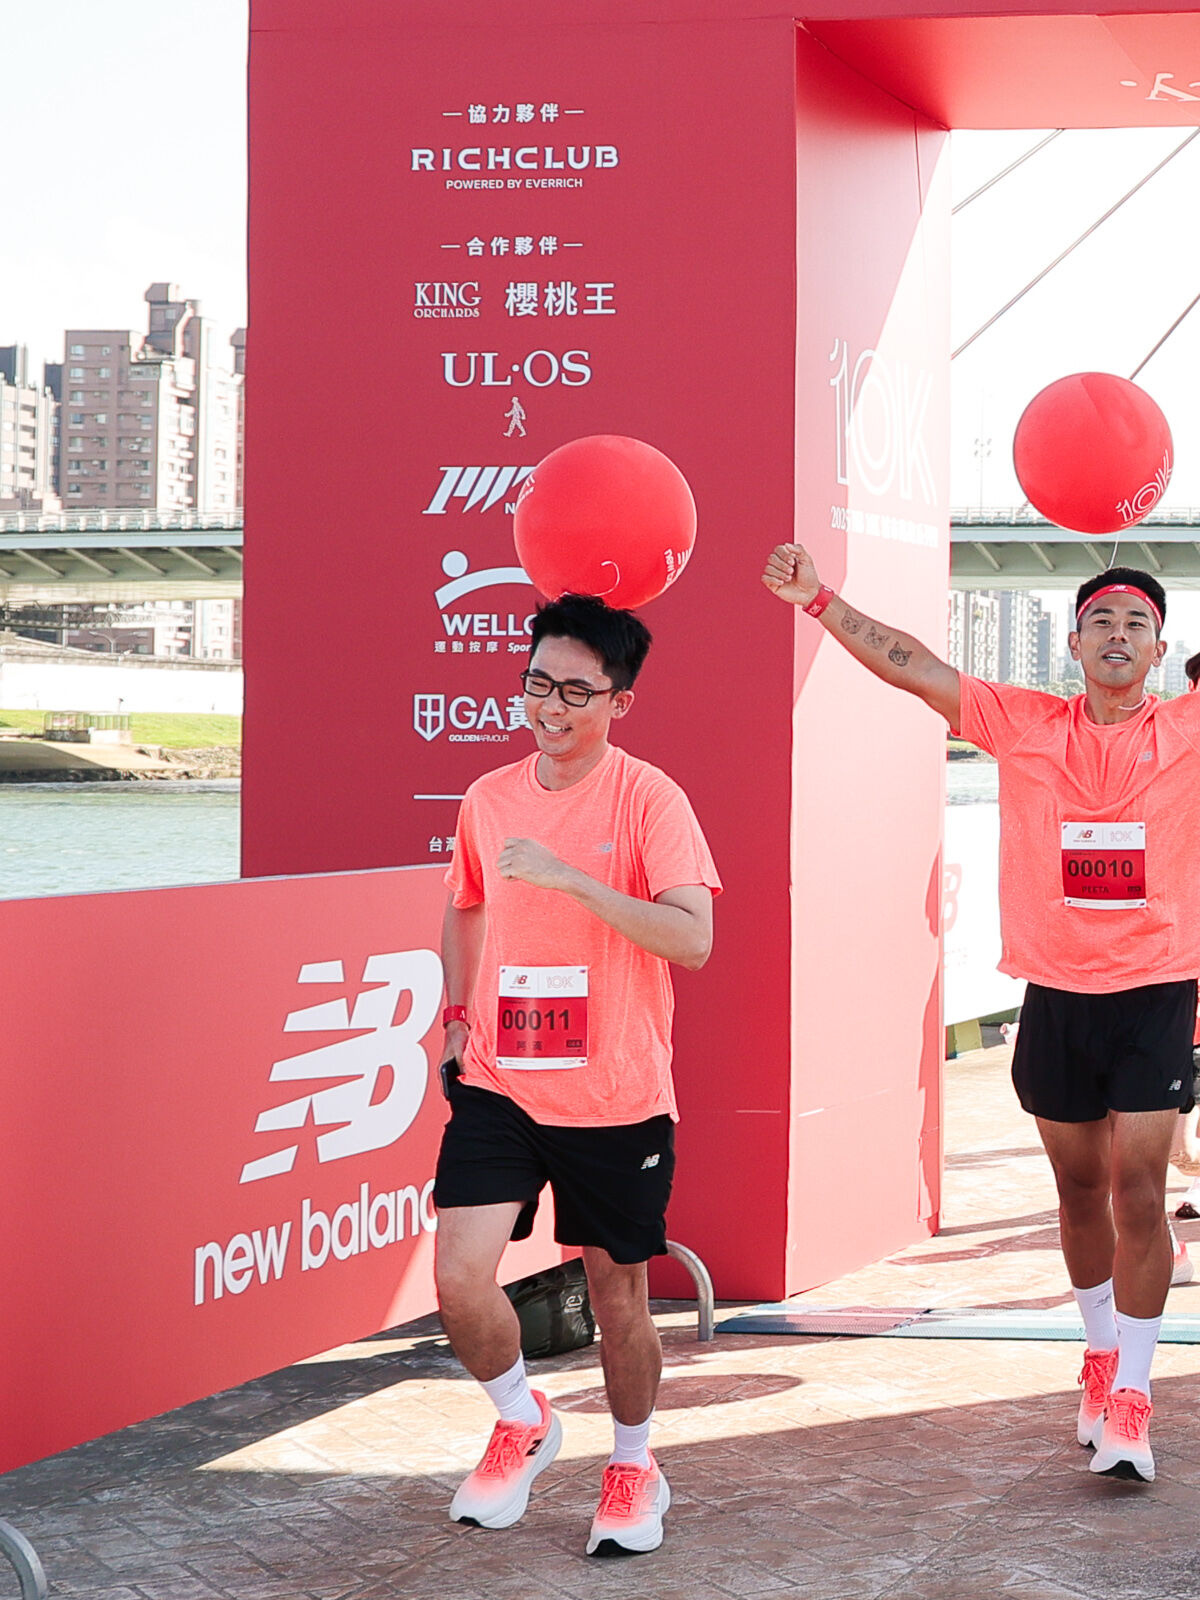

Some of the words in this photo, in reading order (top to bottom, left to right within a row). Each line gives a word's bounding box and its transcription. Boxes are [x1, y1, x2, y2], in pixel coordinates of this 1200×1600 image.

[468, 103, 560, 124] 協力夥伴
[410, 145, 619, 171] RICHCLUB
[446, 179, 504, 190] POWERED
[507, 179, 522, 189] BY
[525, 178, 583, 189] EVERRICH
[467, 236, 558, 256] 合作夥伴
[414, 282, 482, 306] KING
[505, 281, 616, 317] 櫻桃王
[413, 308, 480, 318] ORCHARDS
[434, 641, 498, 653] 運動按摩
[507, 642, 532, 654] Spor
[1068, 860, 1133, 877] 00010
[502, 1009, 570, 1030] 00011
[194, 1221, 293, 1306] new
[301, 1181, 438, 1272] balanc
